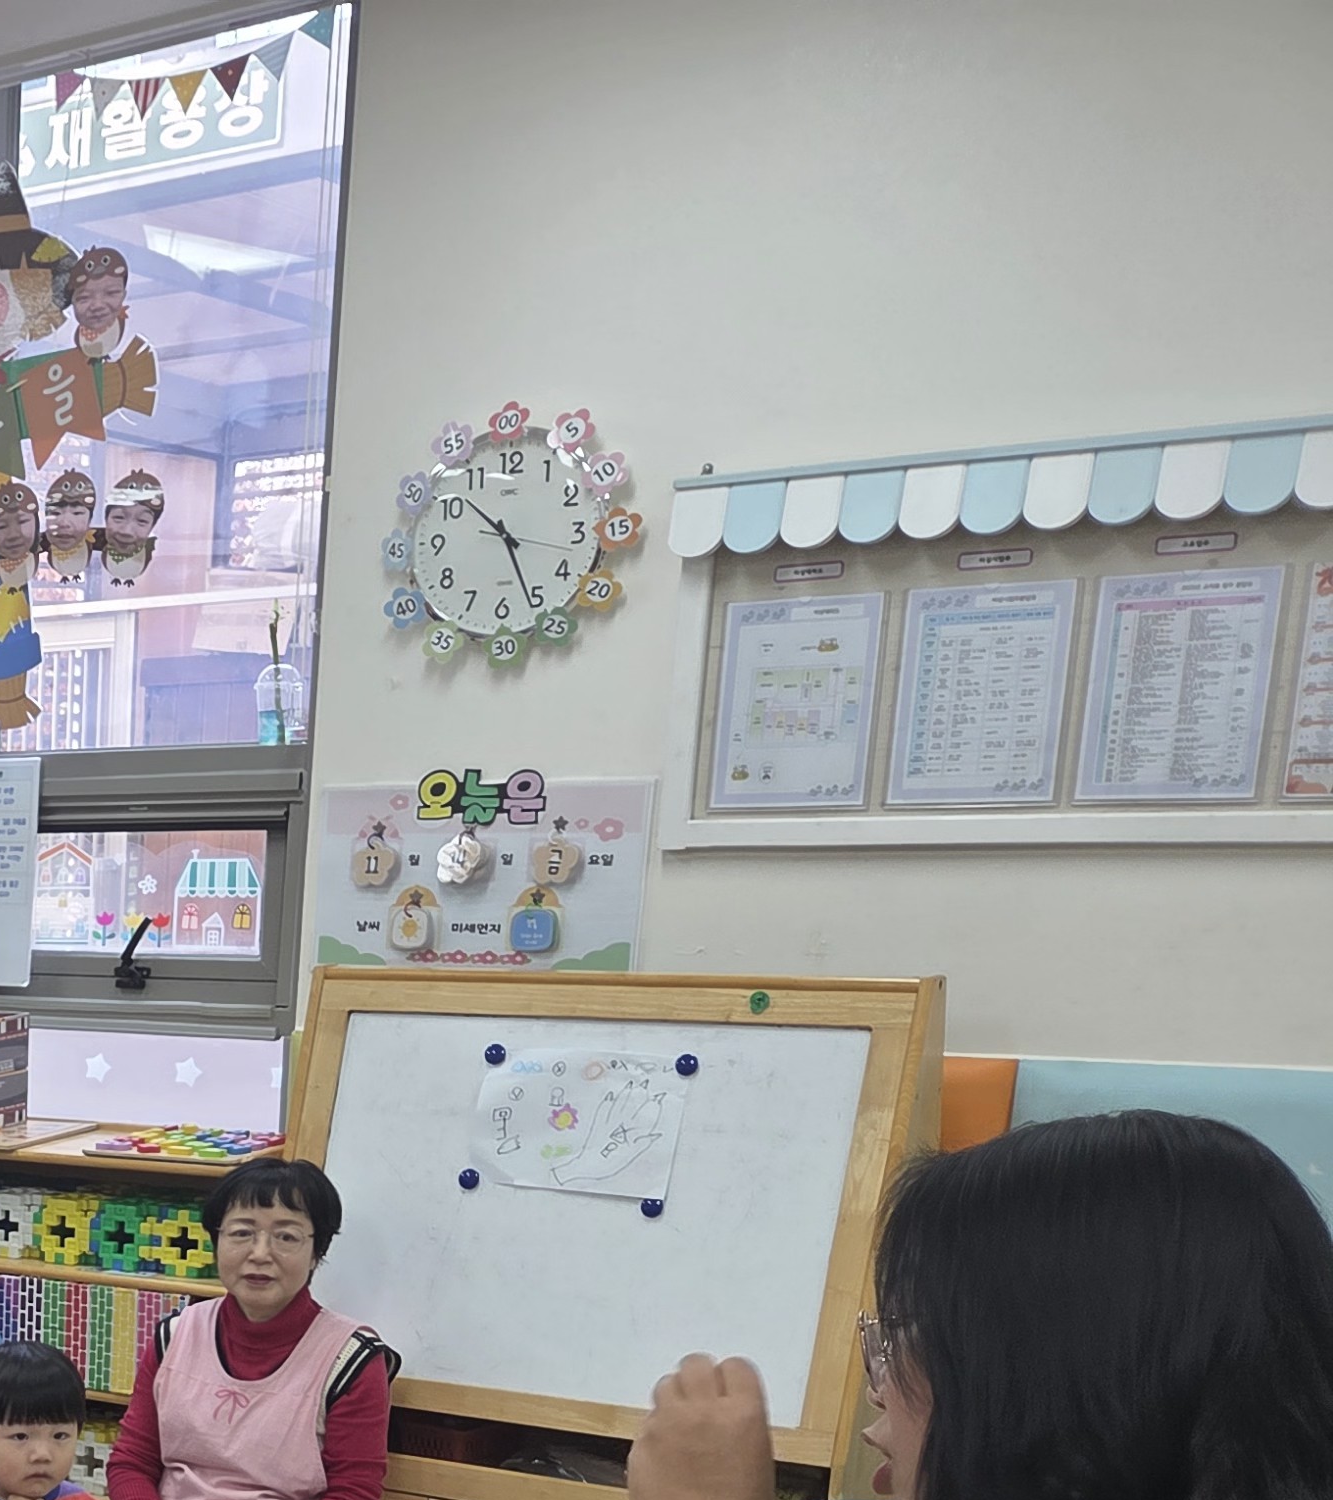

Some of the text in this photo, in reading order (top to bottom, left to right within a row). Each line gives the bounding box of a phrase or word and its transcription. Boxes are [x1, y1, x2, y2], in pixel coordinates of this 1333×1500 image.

[498, 412, 519, 431] 00
[566, 422, 578, 438] 5
[443, 435, 465, 453] 55
[499, 451, 523, 474] 12
[543, 459, 550, 482] 1
[594, 462, 615, 482] 10
[467, 468, 484, 489] 11
[403, 484, 423, 502] 50
[564, 483, 579, 508] 2
[441, 497, 463, 520] 10
[572, 522, 586, 544] 3
[607, 518, 631, 537] 15
[388, 541, 404, 560] 45
[431, 533, 445, 556] 9
[440, 567, 454, 590] 8
[555, 560, 571, 581] 4
[530, 586, 544, 608] 5
[586, 580, 609, 598] 20
[395, 597, 416, 618] 40
[464, 591, 477, 612] 7
[495, 596, 510, 618] 6
[544, 618, 566, 635] 25
[431, 632, 452, 651] 35
[493, 638, 515, 656] 30
[417, 769, 546, 825] 오늘은
[365, 856, 379, 874] 11
[408, 854, 420, 866] 월
[501, 854, 513, 866] 일
[549, 850, 562, 875] 금
[587, 854, 614, 866] 요일
[356, 920, 501, 934] 날씨 미세먼지
